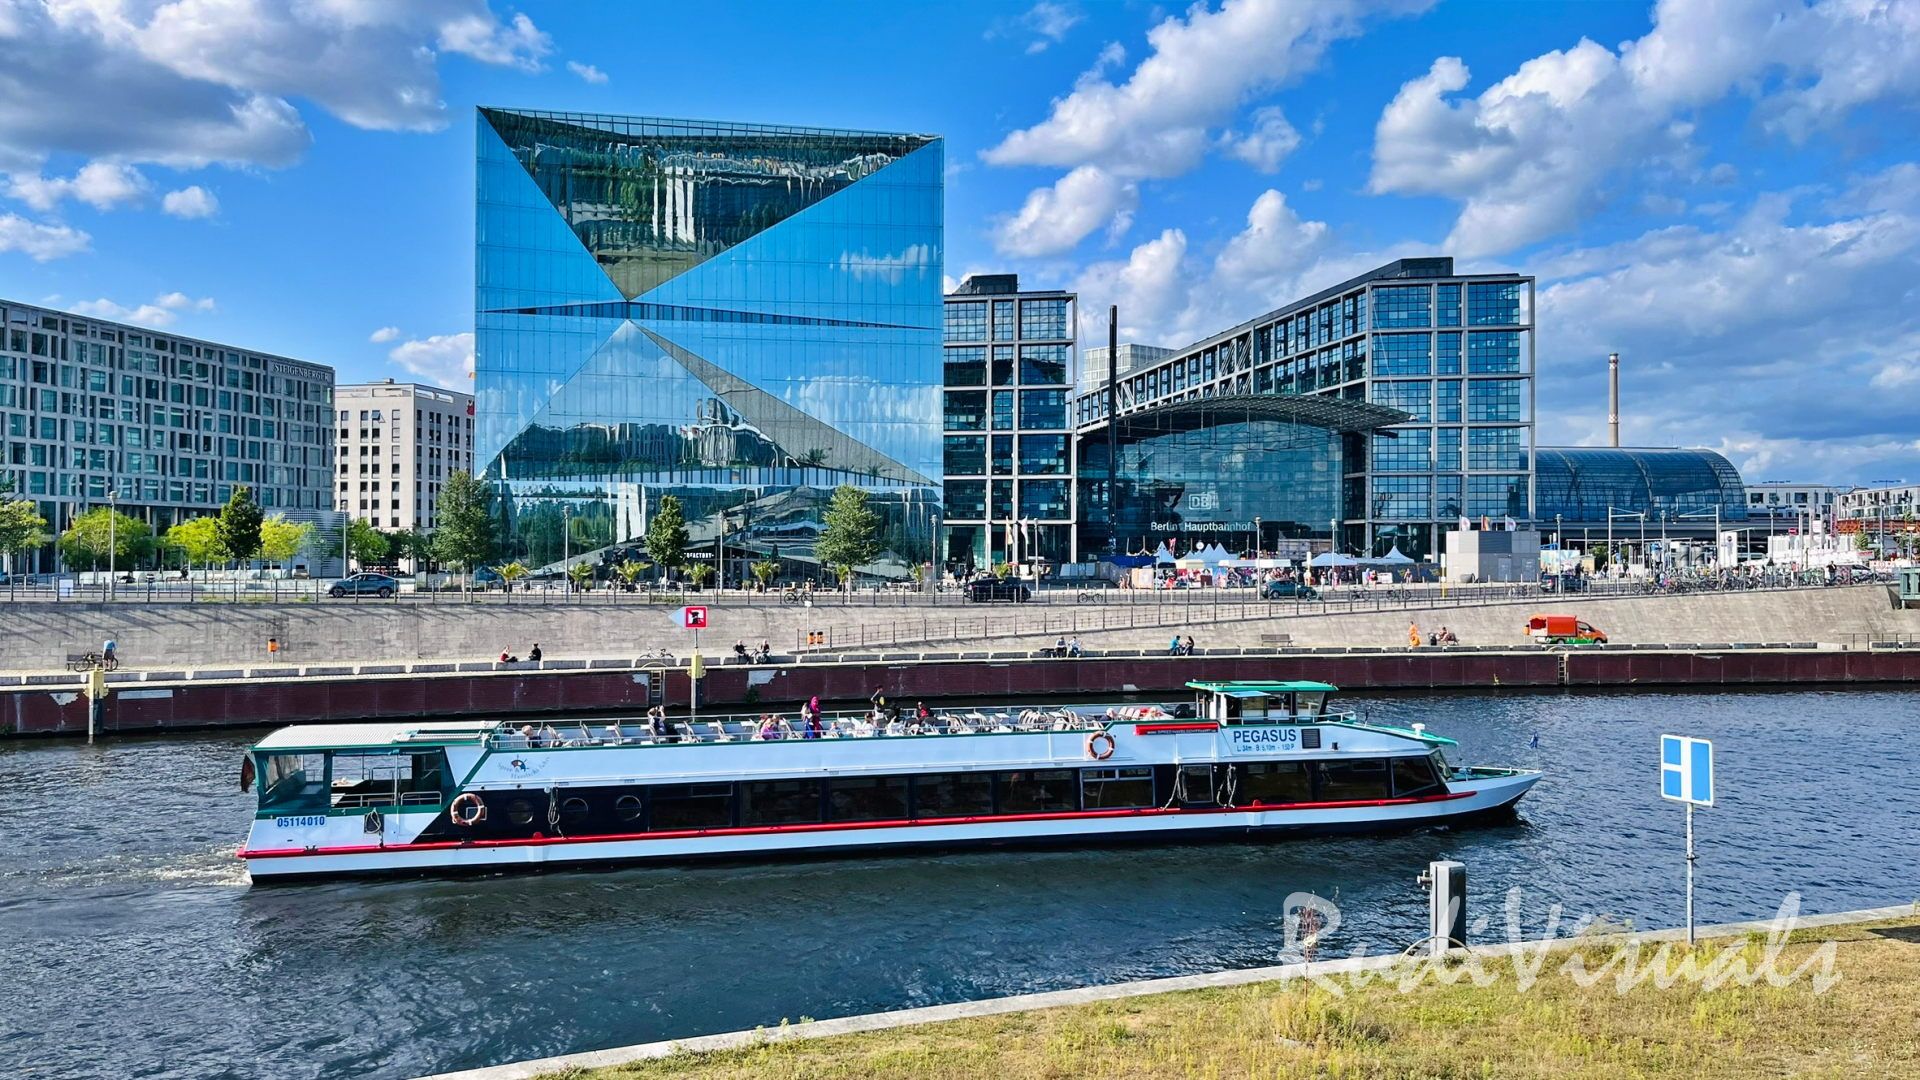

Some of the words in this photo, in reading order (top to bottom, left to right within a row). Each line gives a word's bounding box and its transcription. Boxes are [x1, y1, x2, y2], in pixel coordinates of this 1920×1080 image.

[274, 363, 329, 380] STEIGENBERGER
[1191, 496, 1209, 508] DB
[1151, 521, 1178, 531] Berlin
[1184, 521, 1251, 532] Hauptbahnhof
[1233, 729, 1297, 743] PEGASUS
[277, 816, 325, 827] 05114010
